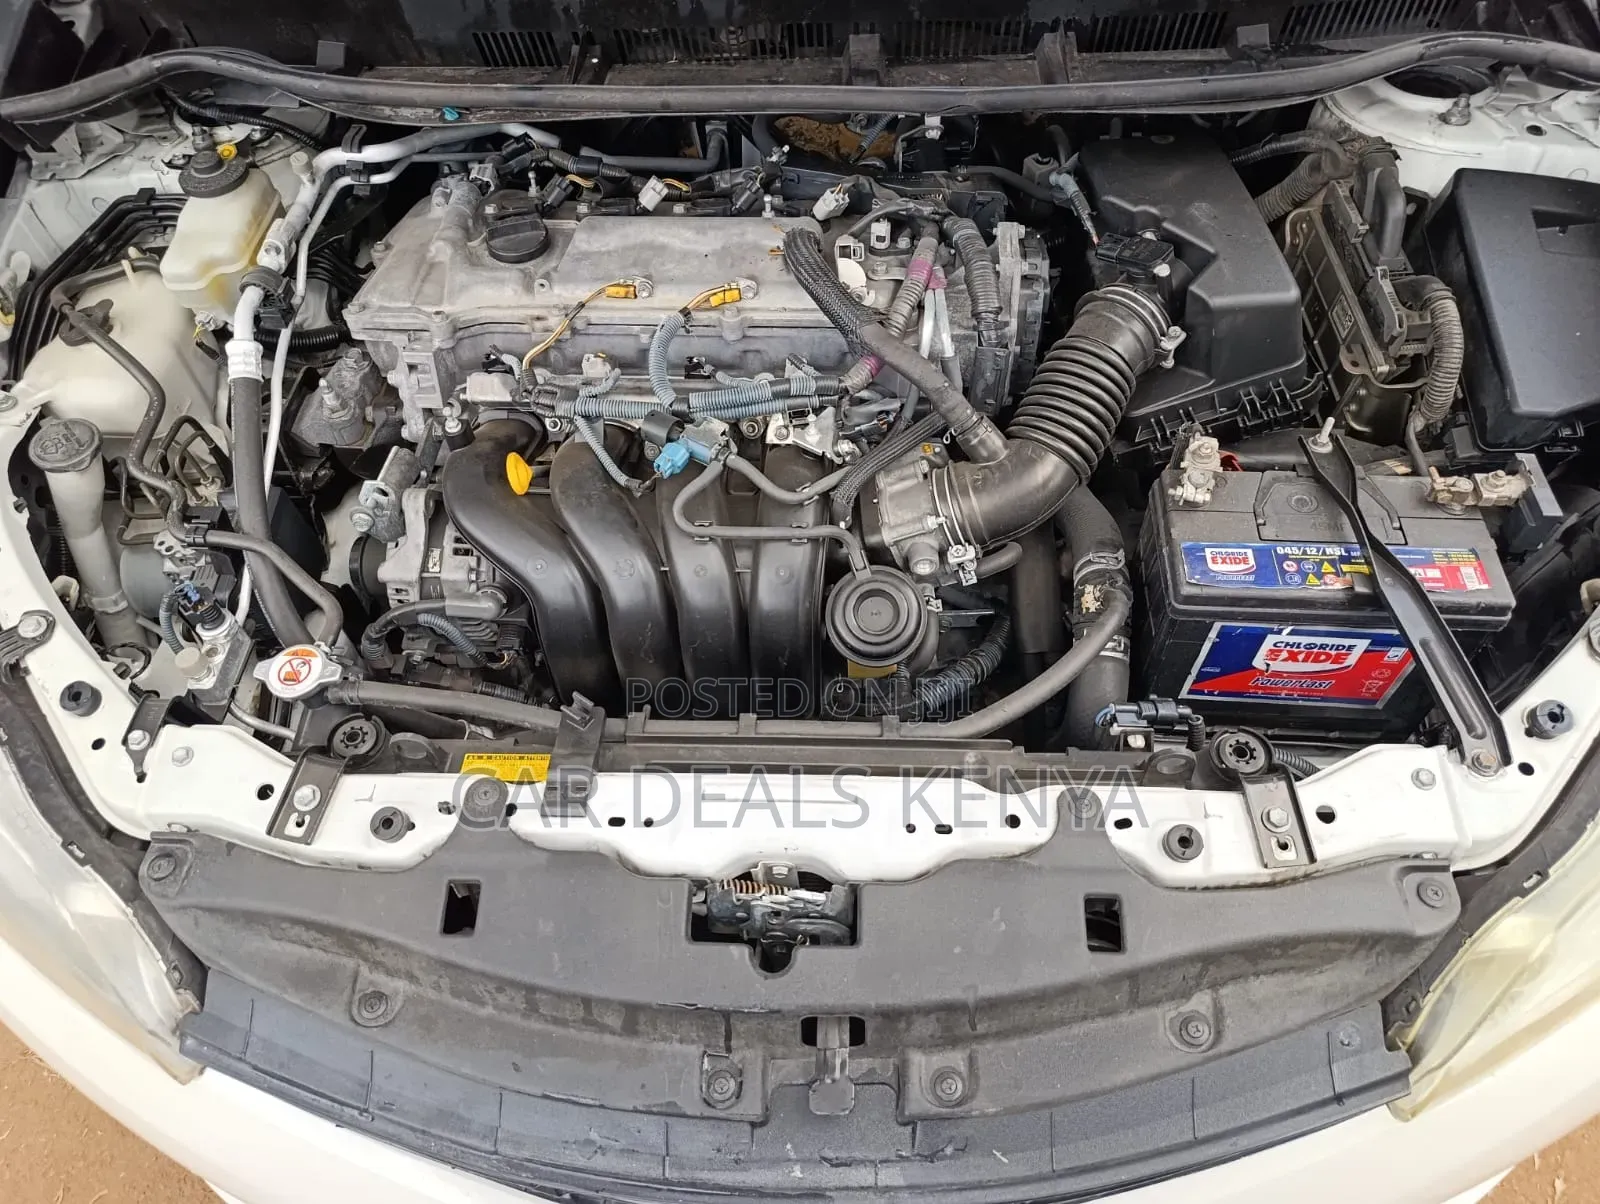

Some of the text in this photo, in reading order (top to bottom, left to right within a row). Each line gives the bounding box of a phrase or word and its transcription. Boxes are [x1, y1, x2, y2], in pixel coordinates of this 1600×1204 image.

[1211, 556, 1250, 565] EXIDE
[1272, 640, 1357, 652] CHLORIDE
[1265, 649, 1350, 665] EXIDE
